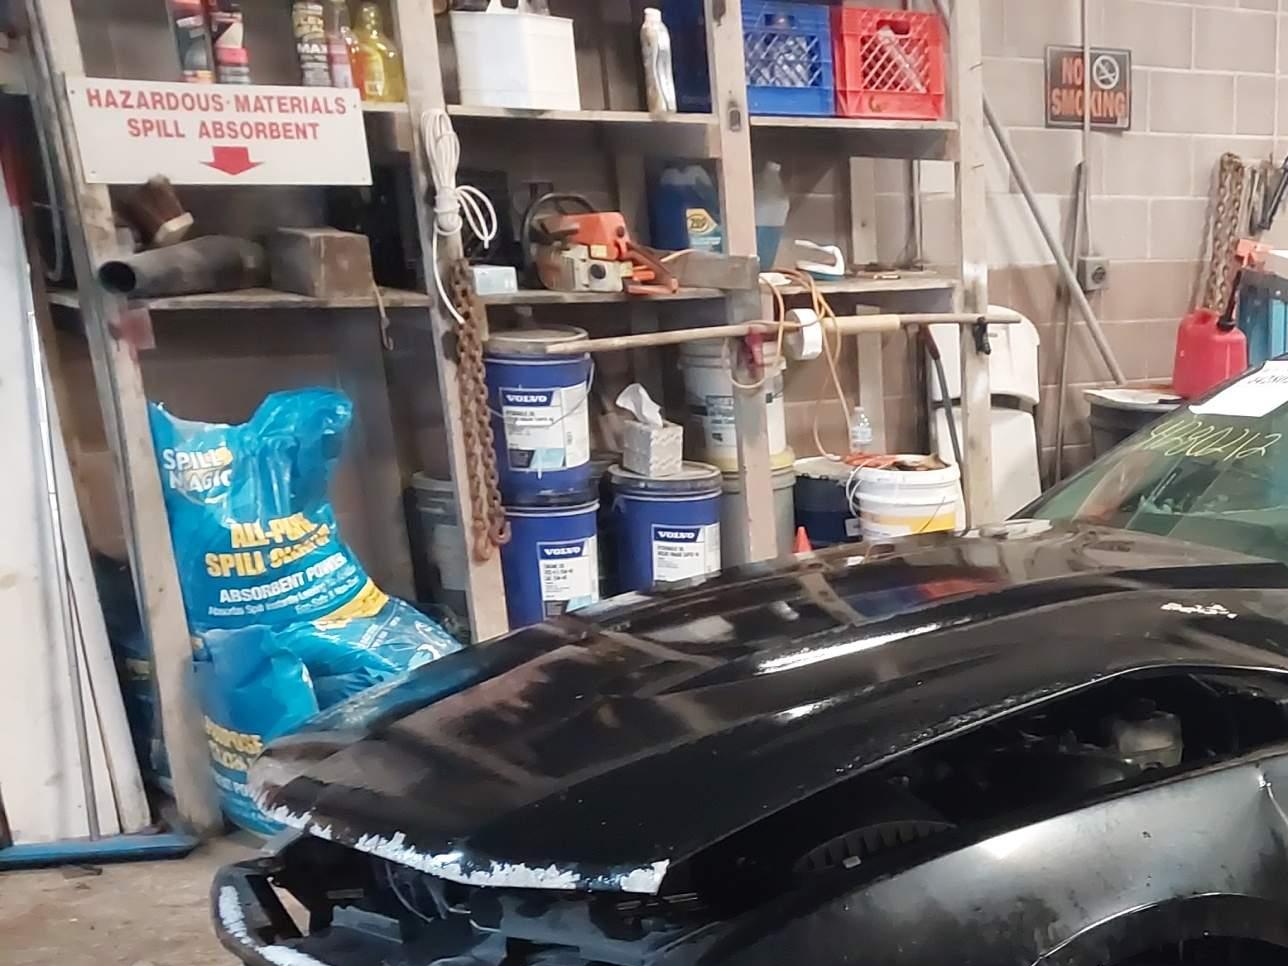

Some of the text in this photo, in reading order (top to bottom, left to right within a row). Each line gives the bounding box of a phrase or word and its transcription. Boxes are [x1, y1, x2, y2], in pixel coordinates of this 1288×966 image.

[1061, 56, 1085, 86] NO
[85, 88, 347, 115] HAZARDOUS MATERIALS
[1051, 87, 1125, 119] SMOKING
[127, 117, 320, 140] SPILL ABSORBENT
[505, 394, 548, 403] VOLVO
[656, 530, 696, 539] VOLVO
[204, 551, 268, 578] SPILL
[543, 546, 581, 556] VOLVO
[219, 571, 305, 604] ABSORBENT
